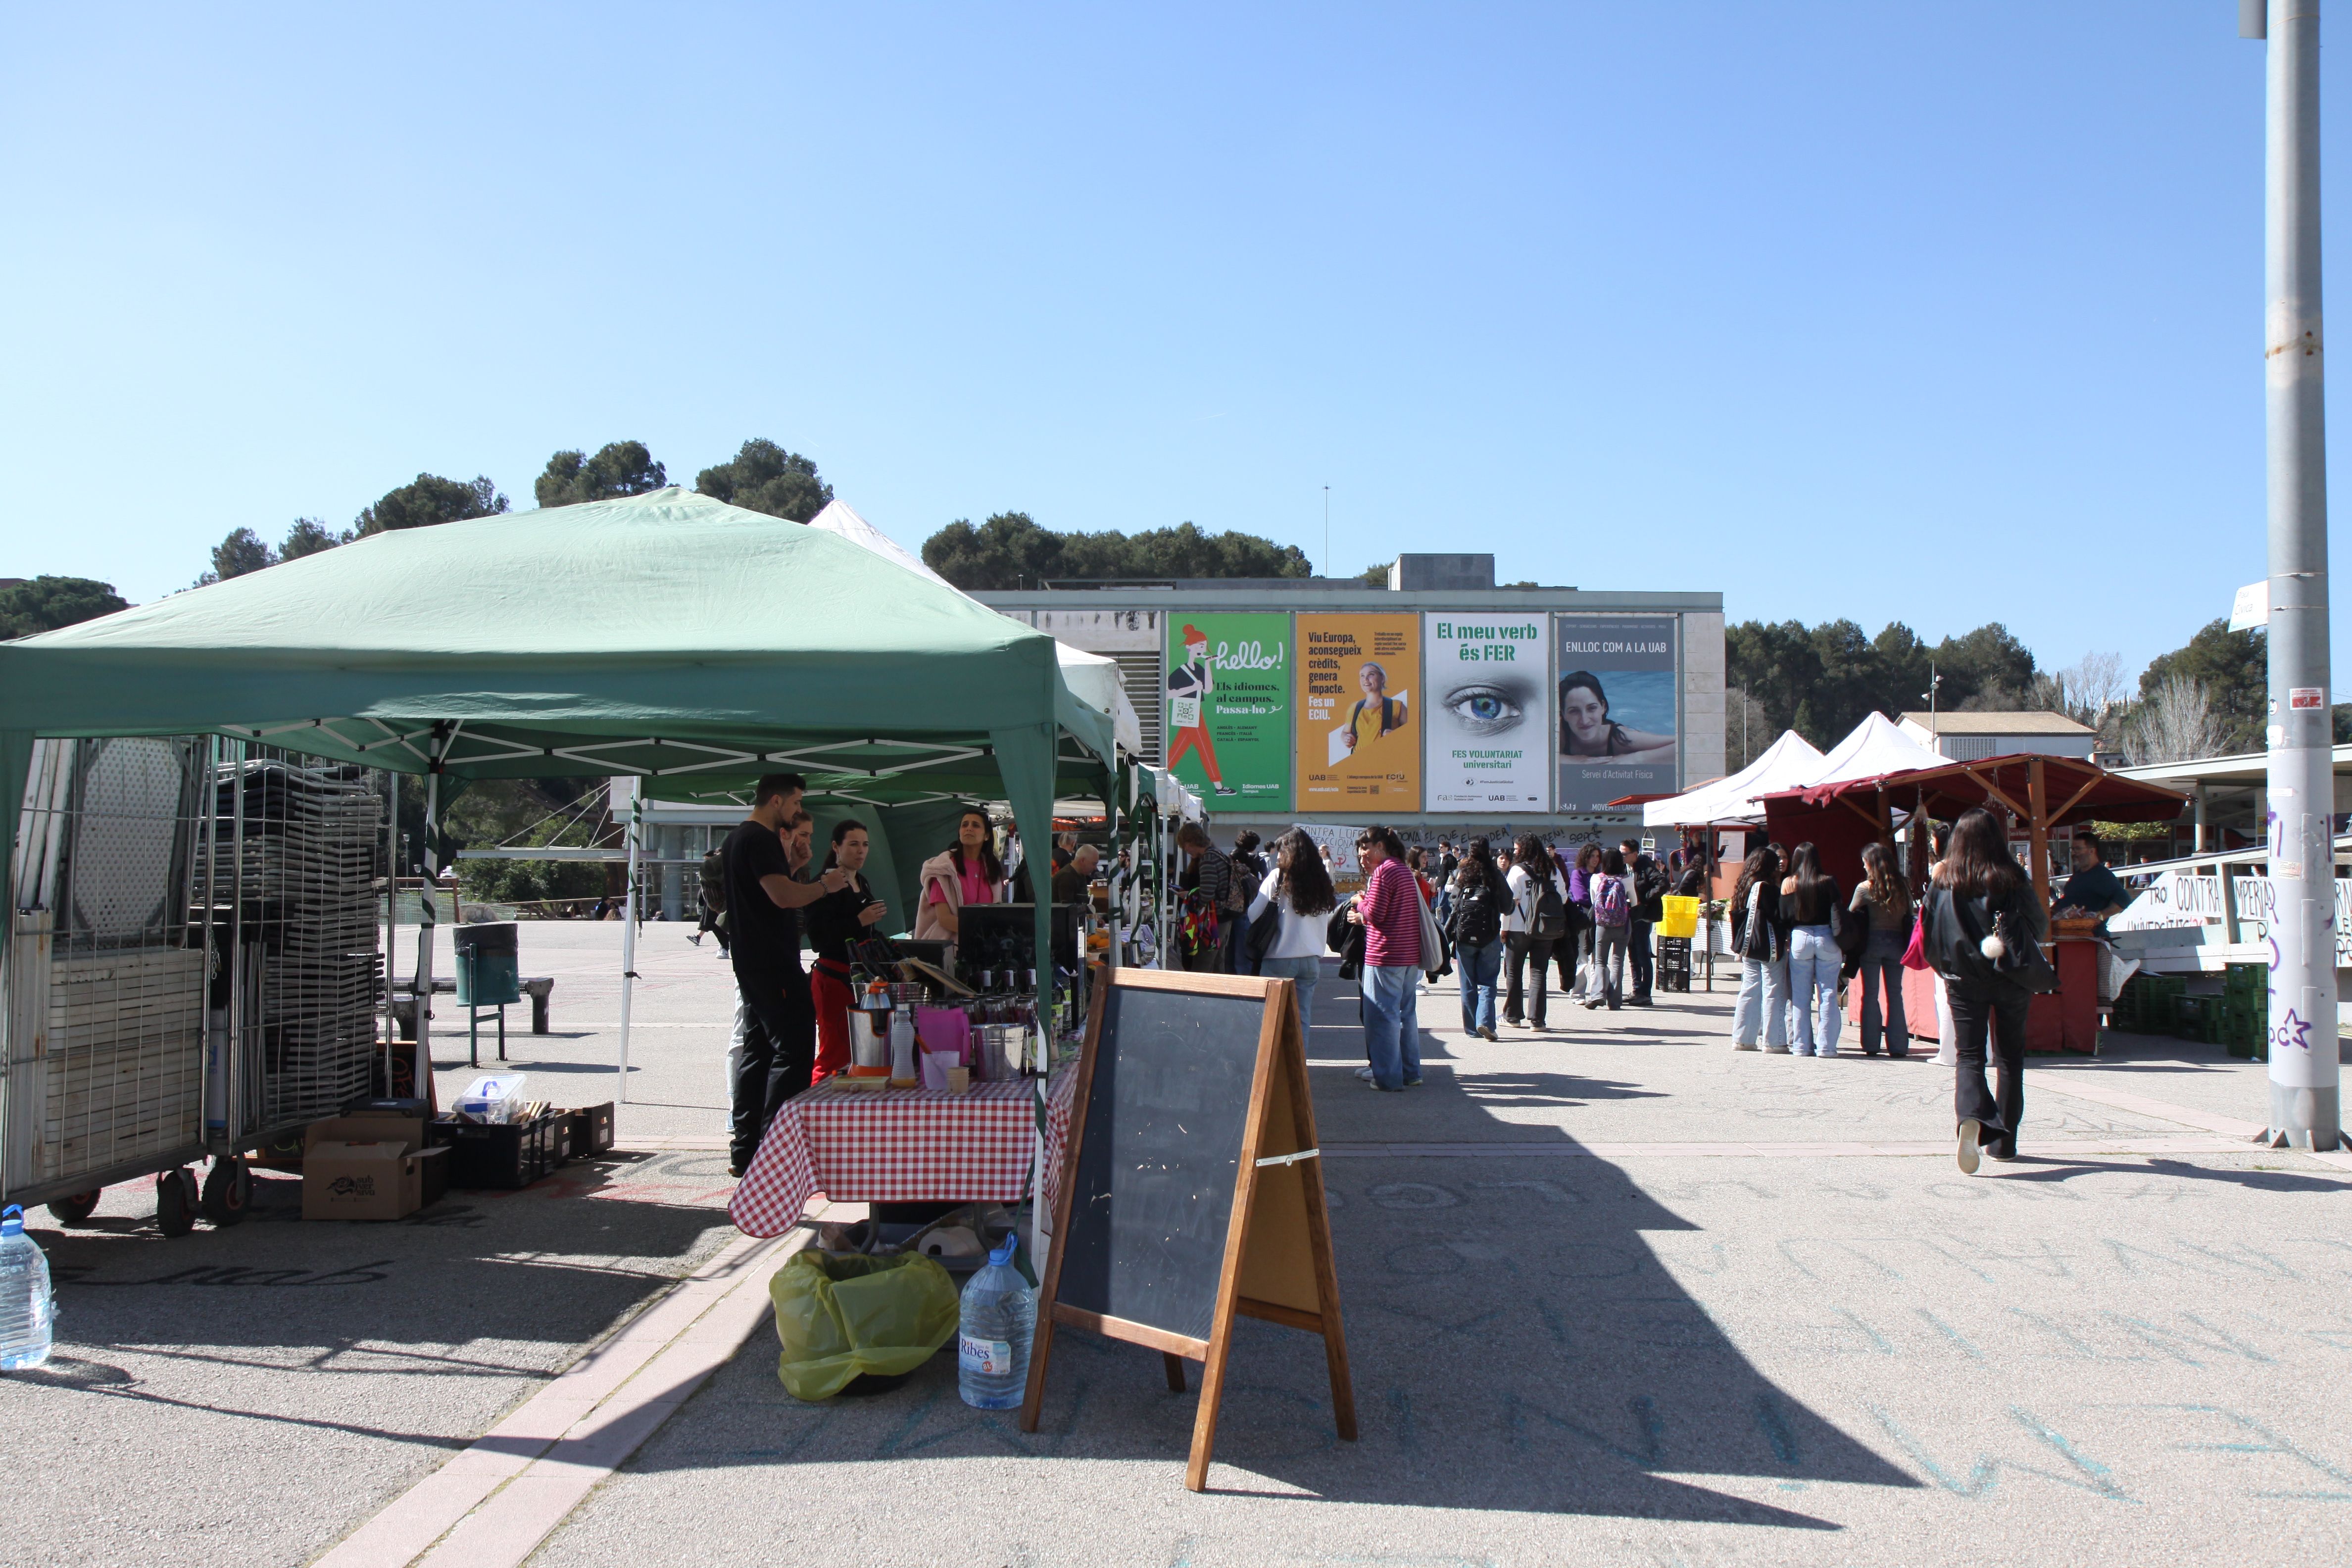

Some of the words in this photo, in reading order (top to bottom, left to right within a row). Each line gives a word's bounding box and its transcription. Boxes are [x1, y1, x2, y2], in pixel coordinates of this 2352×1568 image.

[1437, 622, 1453, 639] El
[1458, 626, 1495, 639] meu
[1498, 623, 1537, 639] verb
[1308, 632, 1322, 642] Viu
[1323, 632, 1356, 645] Europa,
[1308, 644, 1362, 658] aconsegueix
[1459, 643, 1479, 661] és
[1484, 644, 1515, 661] FER
[1566, 641, 1600, 653] ENLLOC
[1602, 641, 1623, 653] COM
[1625, 642, 1632, 653] A
[1634, 642, 1646, 653] LA
[1648, 642, 1667, 653] UAB
[1216, 640, 1283, 670] hello!
[1308, 658, 1341, 671] crèdits,
[1308, 672, 1338, 684] genera
[1216, 682, 1231, 691] Els
[1234, 682, 1280, 692] idiomes,
[1309, 683, 1346, 696] impacte.
[1216, 693, 1226, 702] al
[1228, 695, 1274, 704] campus.
[1308, 695, 1323, 707] Fes
[1323, 698, 1335, 707] un
[1216, 704, 1266, 714] Passa-ho
[1308, 709, 1331, 720] ECIU.
[1452, 750, 1467, 758] FES
[1469, 750, 1523, 759] VOLUNTARIAT
[1463, 759, 1512, 769] universitari
[1581, 769, 1601, 779] Servei
[1603, 769, 1633, 779] d'Activitat
[1635, 770, 1653, 779] Física
[1437, 830, 1459, 843] QUE
[2176, 876, 2221, 913] CONTRA
[356, 1175, 374, 1183] sub
[961, 1337, 990, 1360] Ribes
